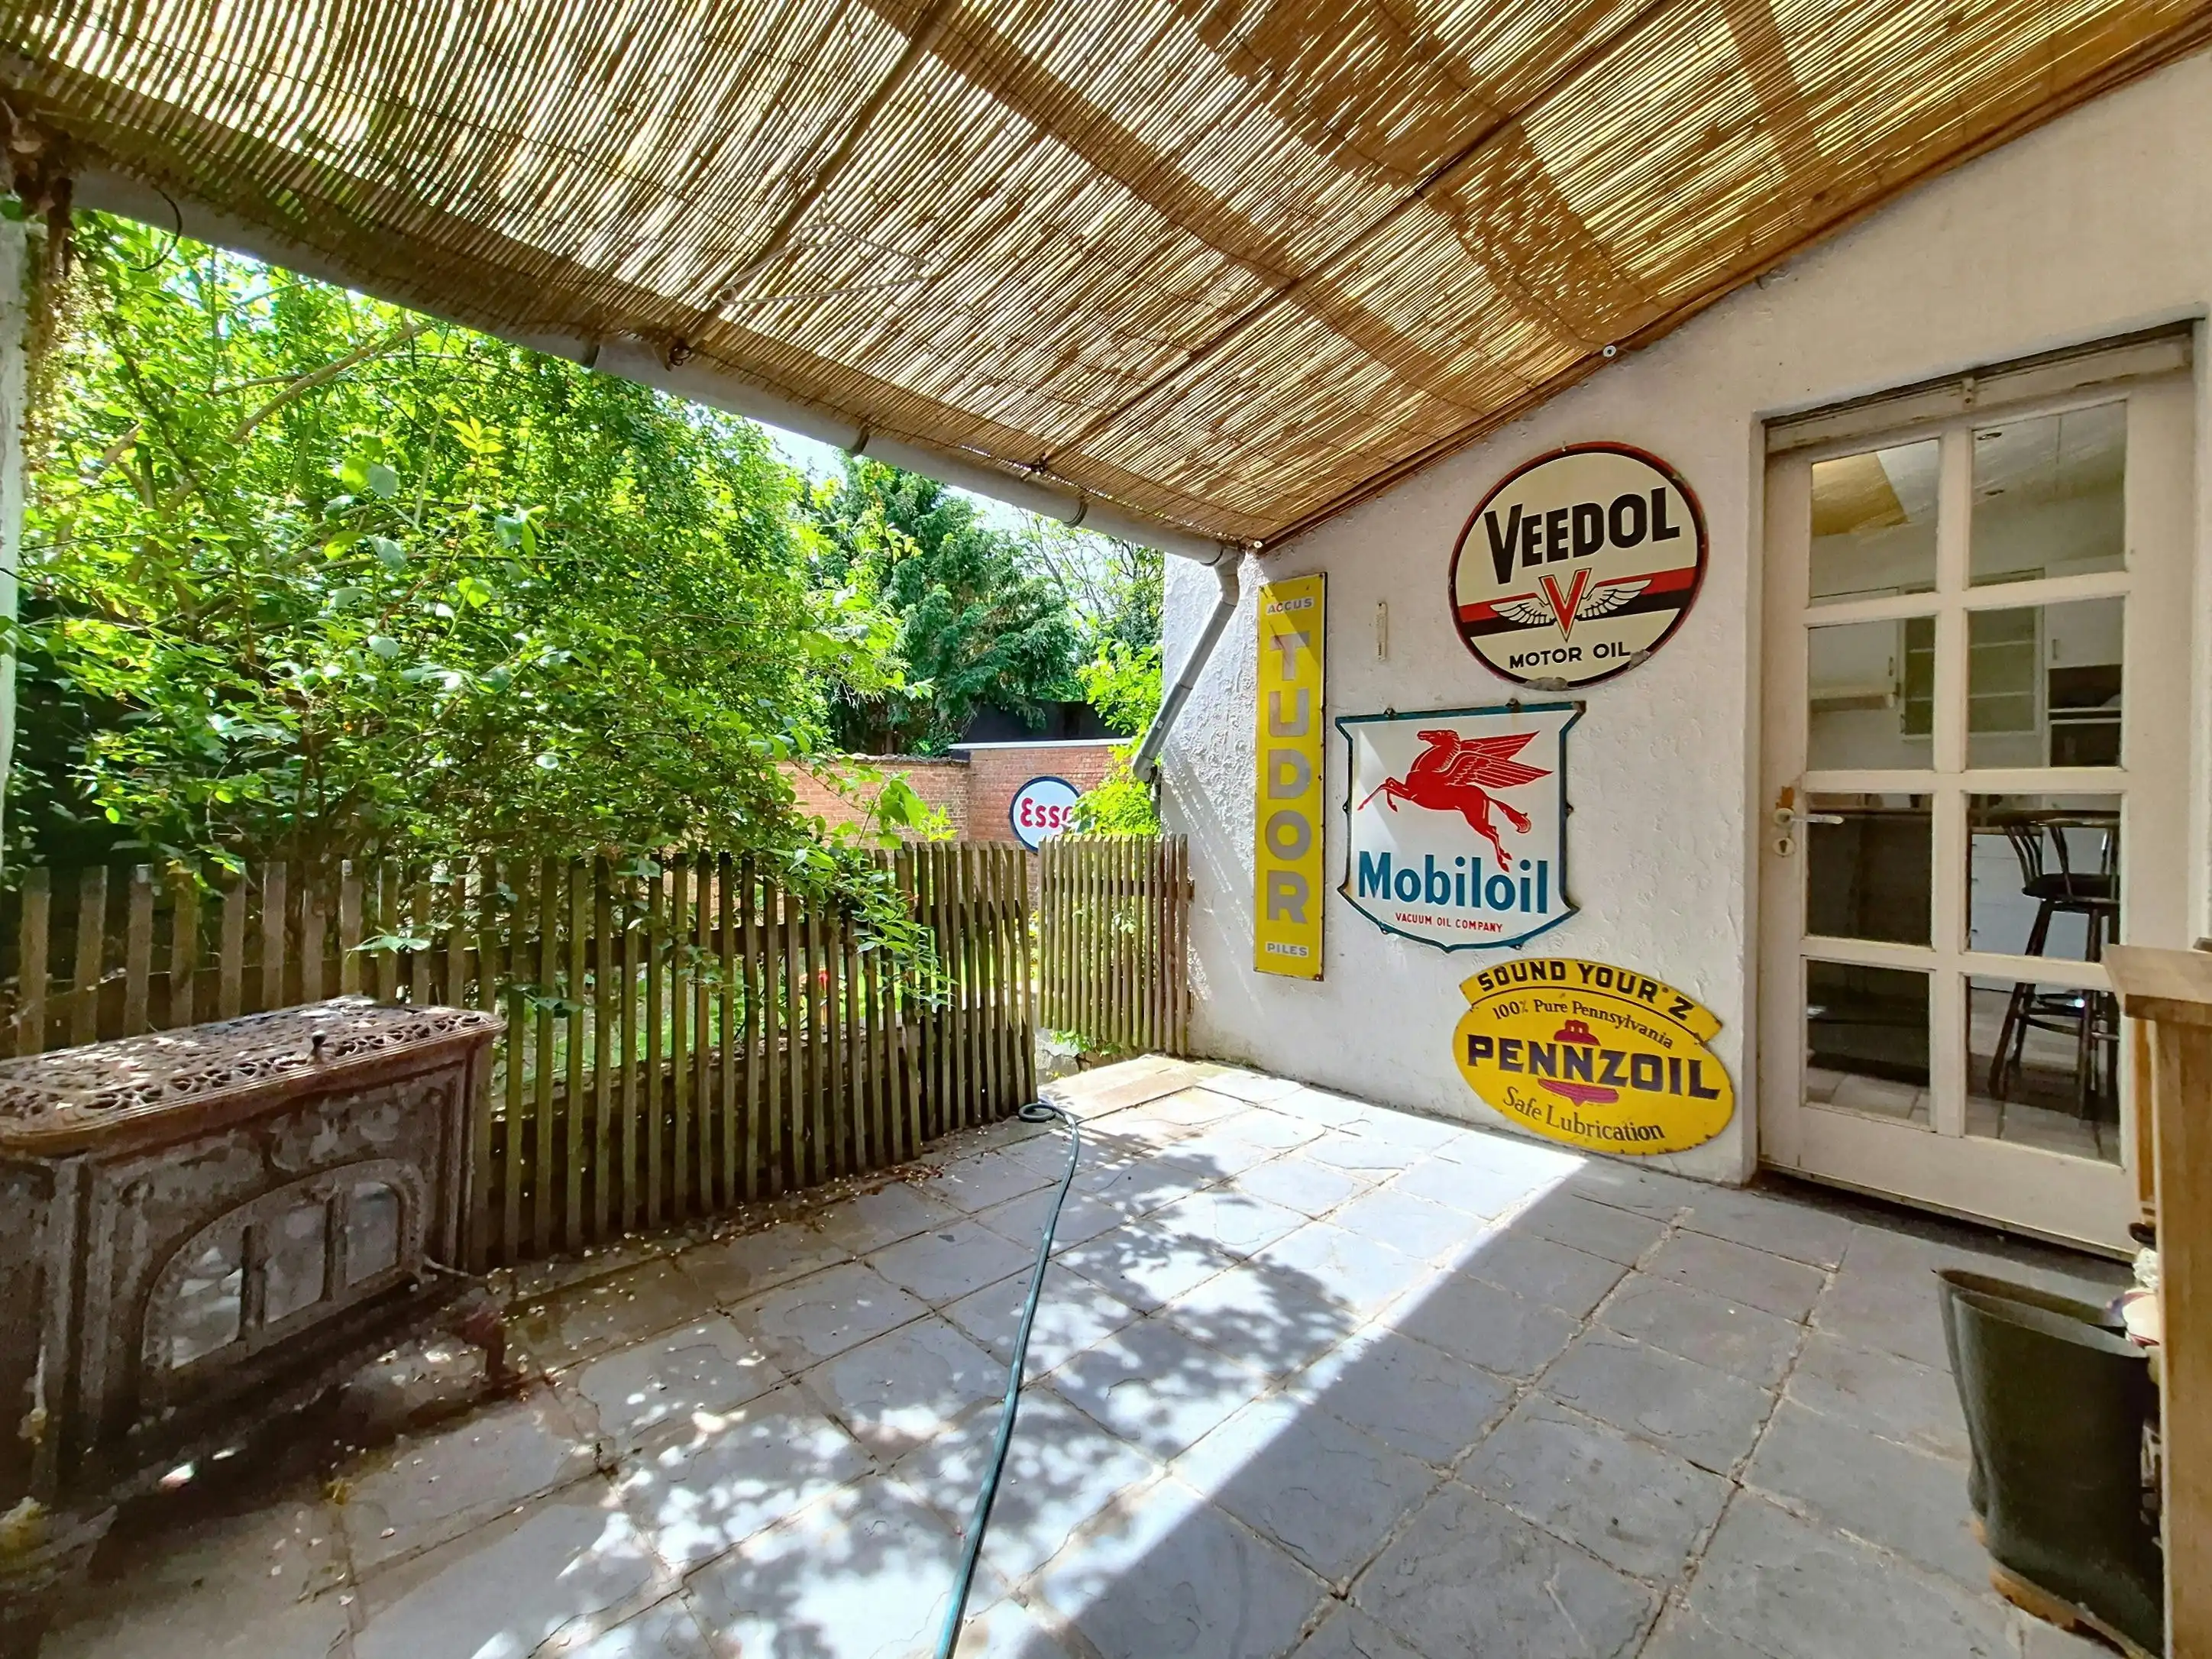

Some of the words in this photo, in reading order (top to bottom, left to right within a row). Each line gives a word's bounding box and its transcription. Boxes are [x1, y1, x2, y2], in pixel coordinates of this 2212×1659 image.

[1484, 487, 1680, 584] VEEDOL
[1267, 598, 1313, 613] ACCUS
[1509, 646, 1582, 669] MOTOR
[1593, 642, 1631, 664] OIL
[1265, 631, 1312, 923] TUDOR
[1359, 850, 1548, 914] Mobiloil
[1395, 913, 1432, 925] VACUUM
[1437, 917, 1452, 927] OIL
[1455, 919, 1503, 933] COMPANY
[1267, 943, 1308, 956] PILES
[1477, 961, 1566, 992] SOUND
[1534, 998, 1568, 1013] Pure
[1572, 1000, 1674, 1050] Pennsylvania
[1467, 1034, 1720, 1101] PENNZOIL
[1502, 1086, 1542, 1121] Safe
[1546, 1104, 1666, 1141] Lubrication
